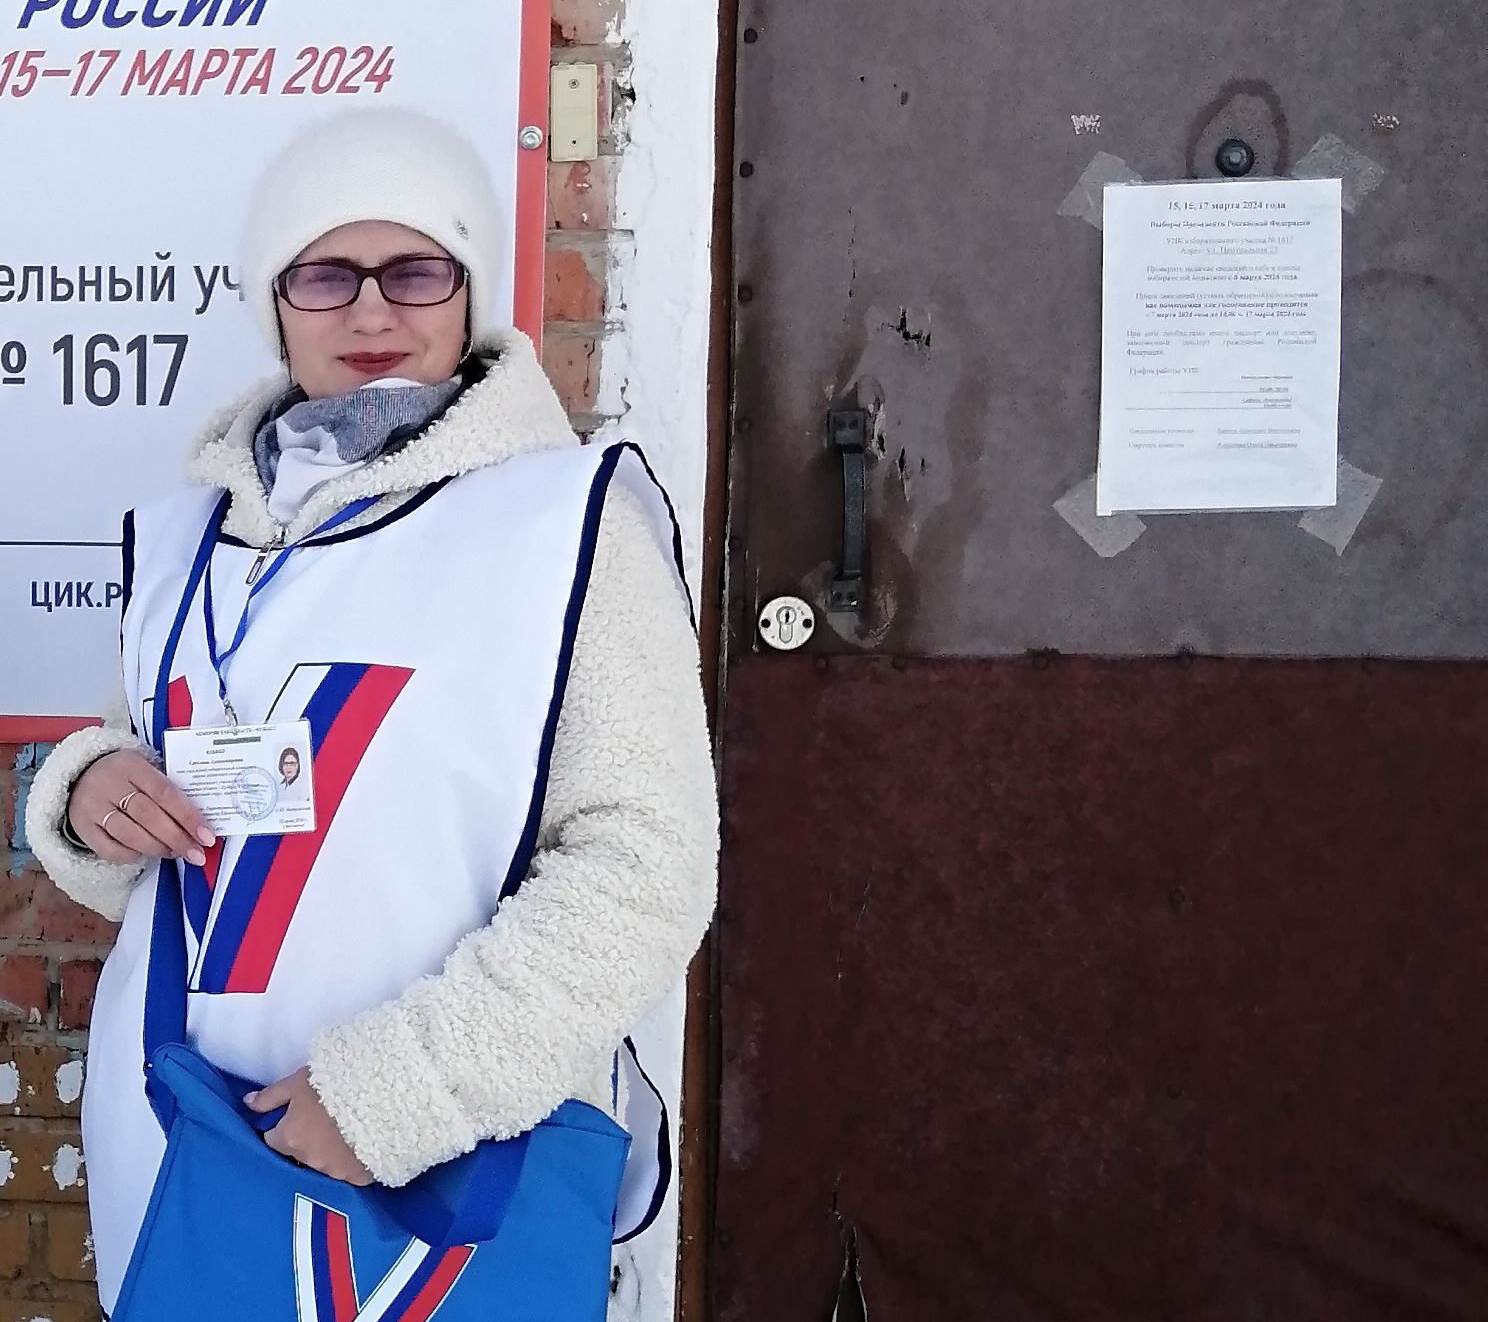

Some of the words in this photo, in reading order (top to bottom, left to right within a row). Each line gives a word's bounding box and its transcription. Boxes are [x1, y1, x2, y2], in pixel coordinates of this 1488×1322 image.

[122, 47, 276, 97] МАРТА
[280, 45, 395, 95] 2024
[52, 333, 189, 407] 1617
